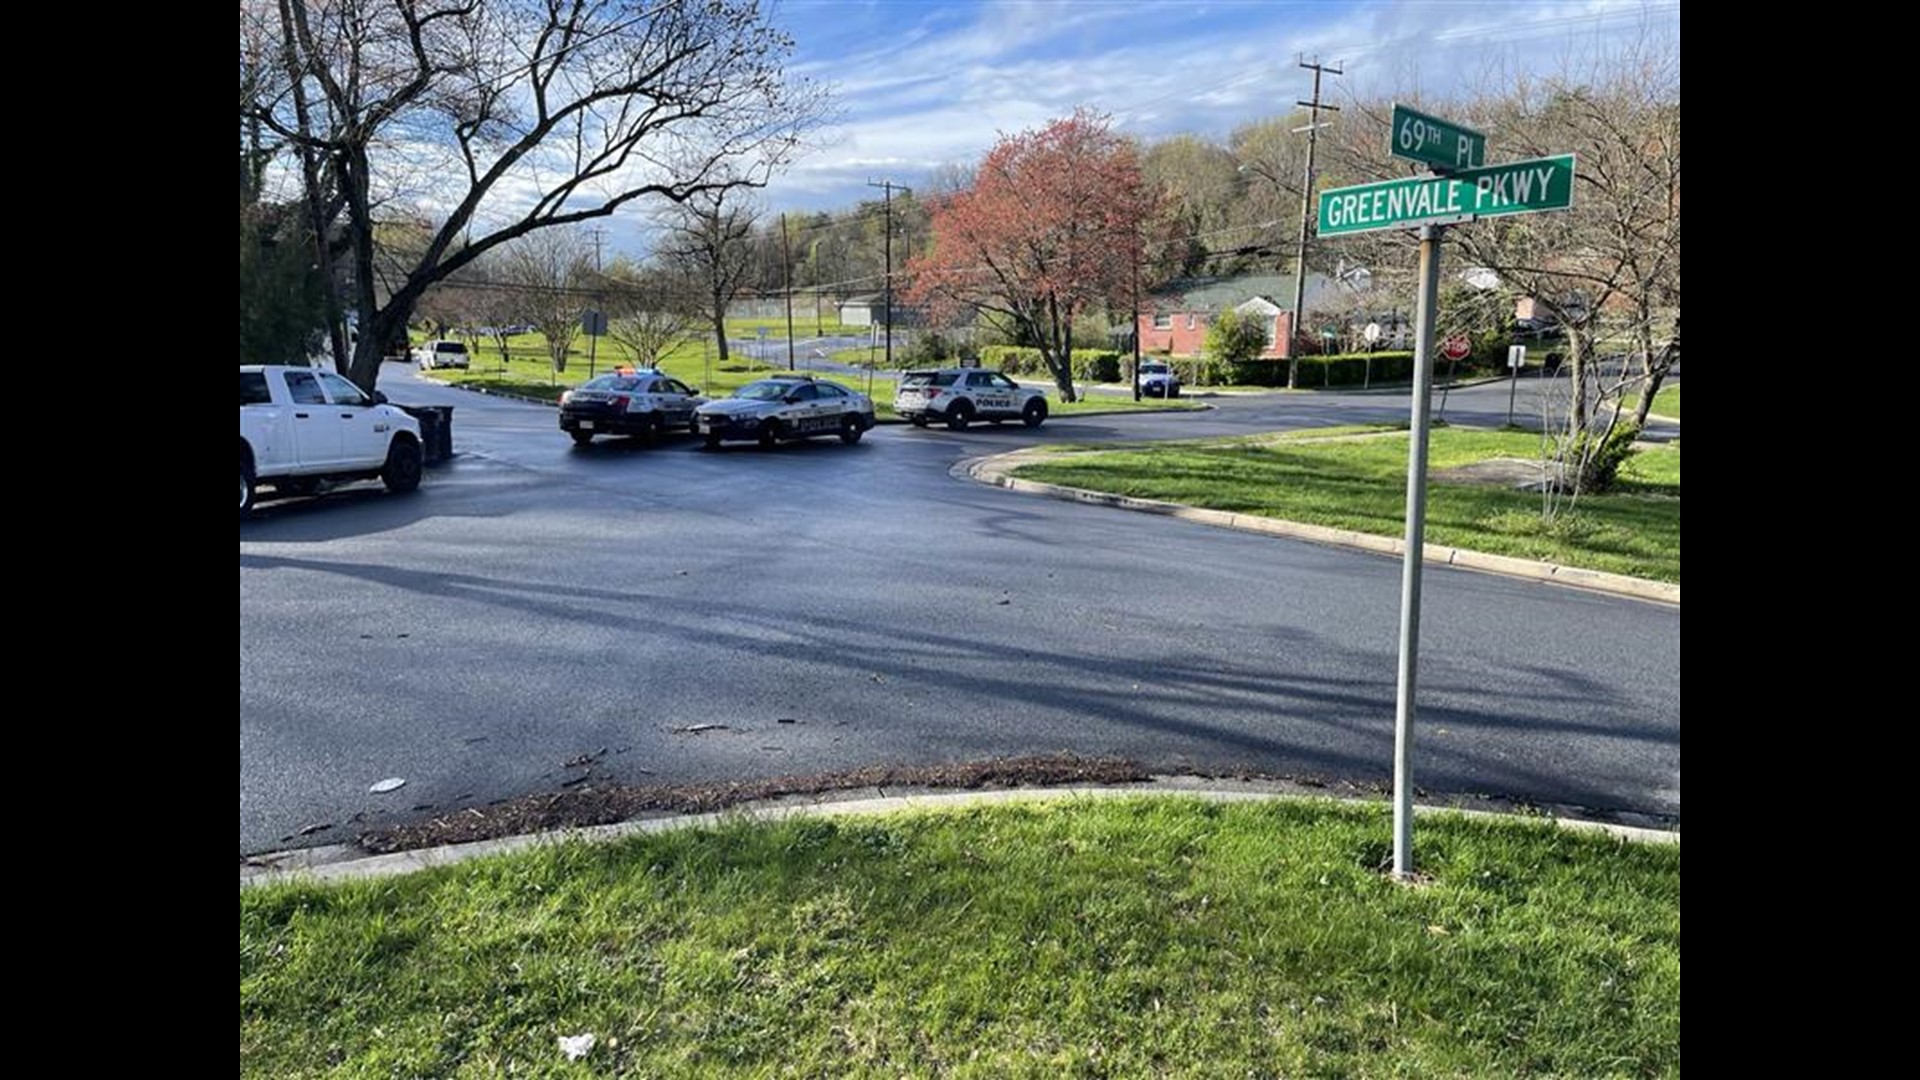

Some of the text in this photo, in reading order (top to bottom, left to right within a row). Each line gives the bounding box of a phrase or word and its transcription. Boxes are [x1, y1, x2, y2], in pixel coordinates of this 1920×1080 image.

[1400, 116, 1475, 169] 69TH PL
[1327, 166, 1555, 226] GREENVALE PKWY
[975, 398, 1011, 408] POLICE
[800, 418, 840, 432] POLICE
